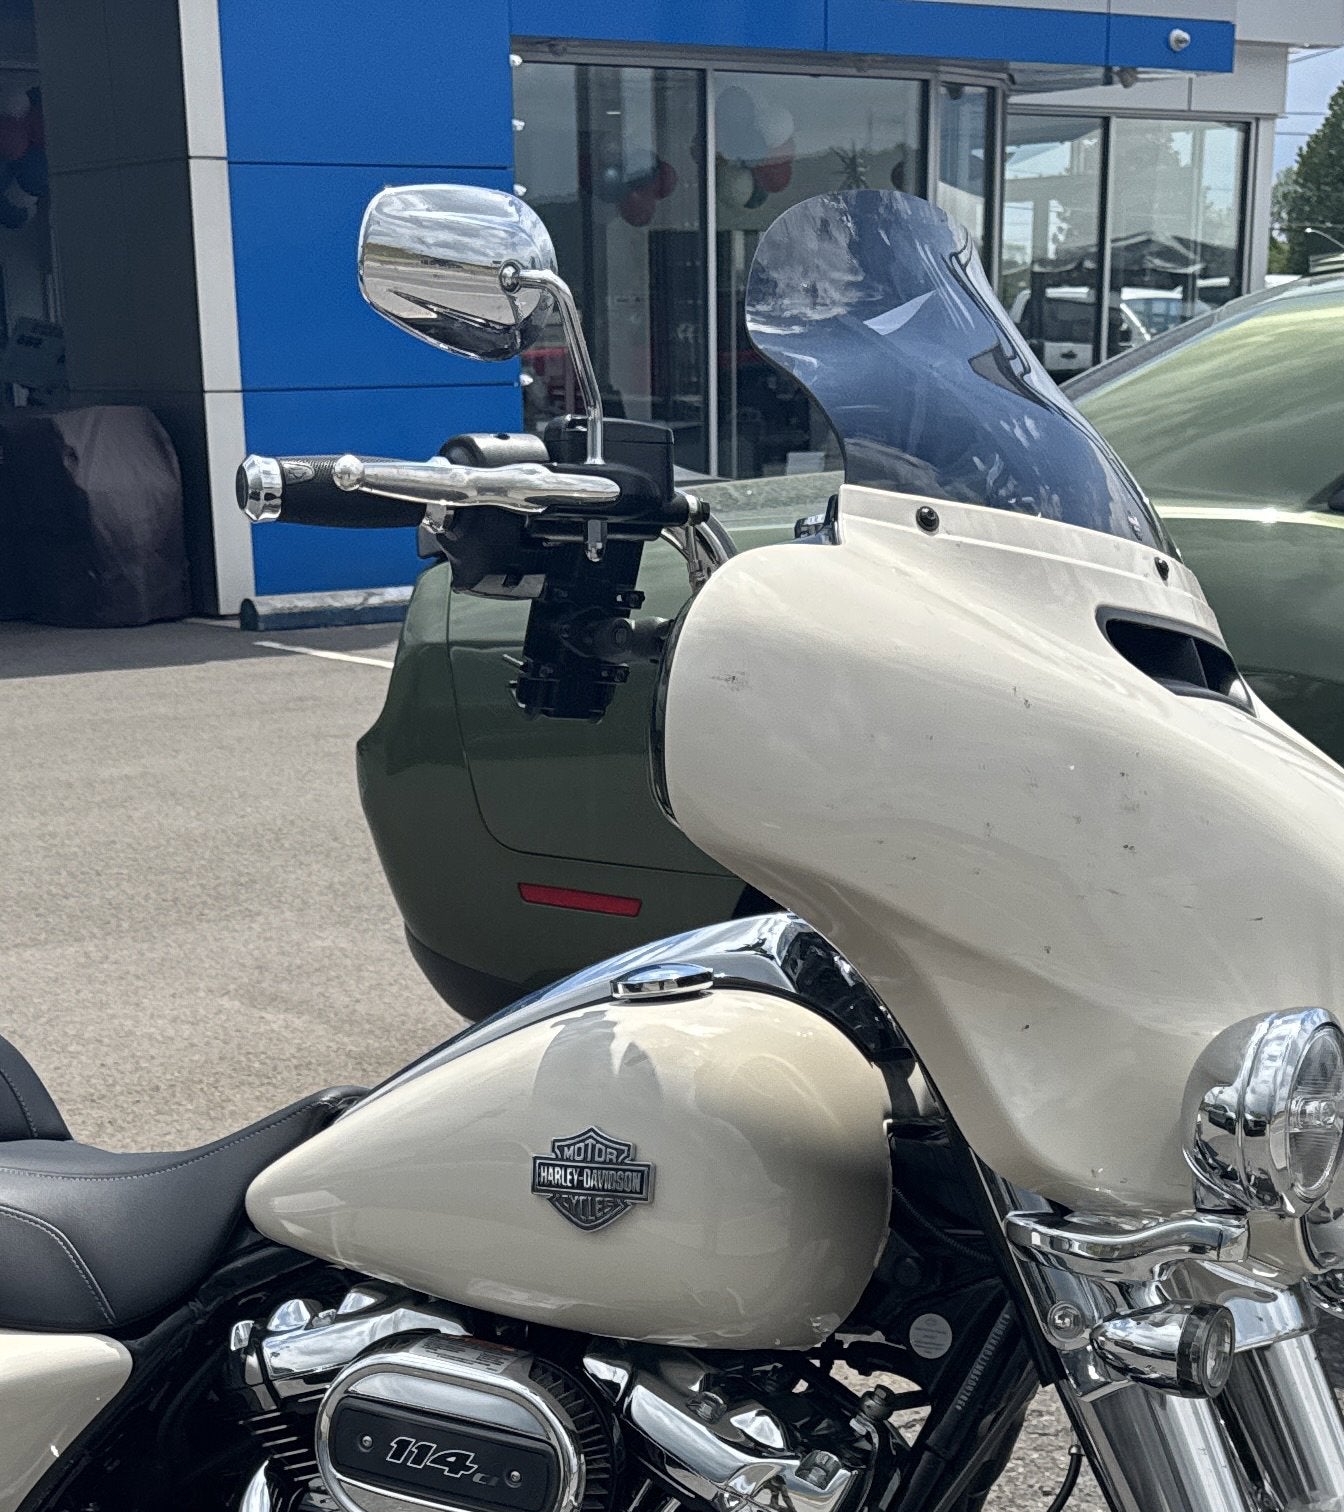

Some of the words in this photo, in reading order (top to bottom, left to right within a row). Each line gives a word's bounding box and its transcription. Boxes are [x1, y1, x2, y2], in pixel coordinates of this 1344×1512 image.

[563, 1138, 618, 1163] MOTOR
[539, 1165, 642, 1193] HARLEY-DAVIDSON
[559, 1194, 616, 1221] CYCLES
[386, 1436, 479, 1478] 114
